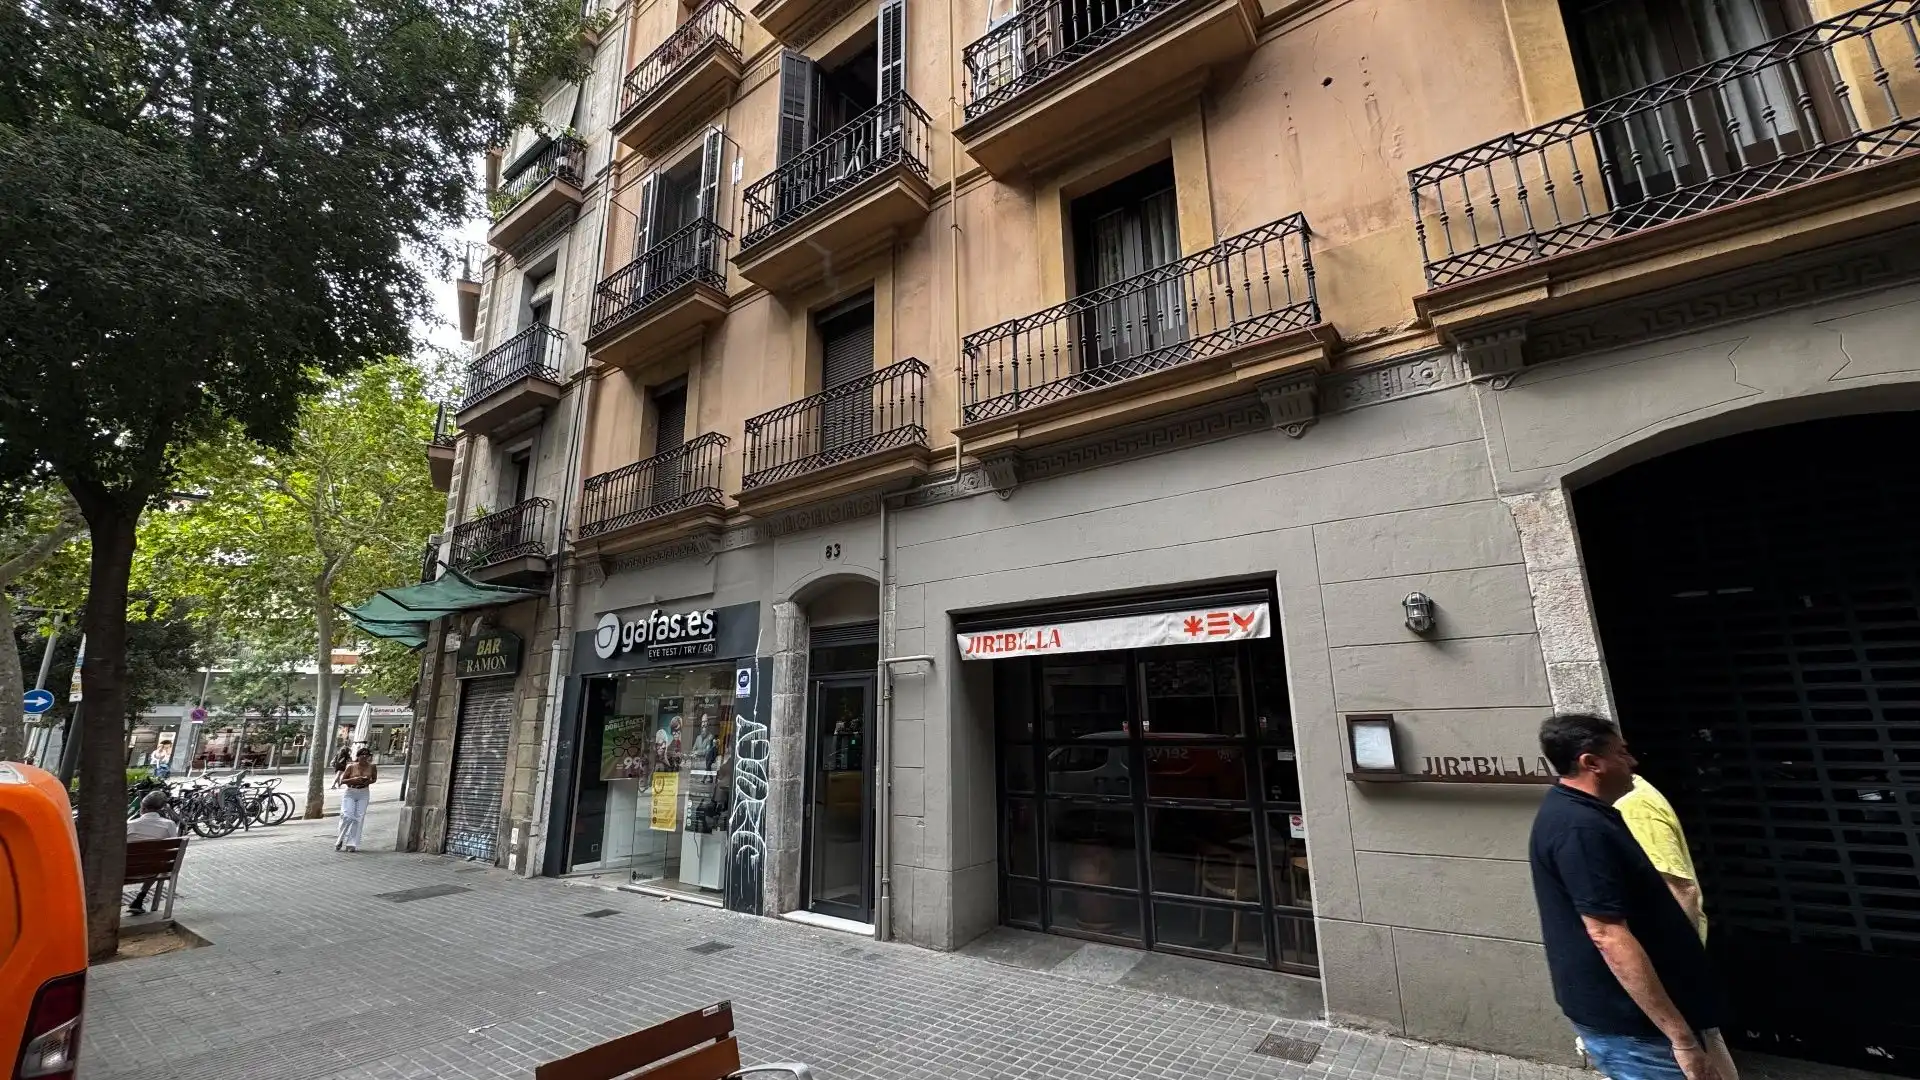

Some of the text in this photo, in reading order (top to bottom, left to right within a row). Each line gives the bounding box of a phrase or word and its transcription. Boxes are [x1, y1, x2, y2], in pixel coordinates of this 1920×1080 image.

[622, 608, 715, 653] gafas.es
[476, 637, 502, 656] BAR
[648, 649, 660, 658] EYE
[662, 647, 677, 657] TEST
[684, 645, 697, 656] TRY
[702, 643, 714, 653] GO
[965, 629, 1061, 654] JIRIBILLA
[466, 654, 508, 673] RAMON
[1422, 756, 1557, 777] JIRIBILLA
